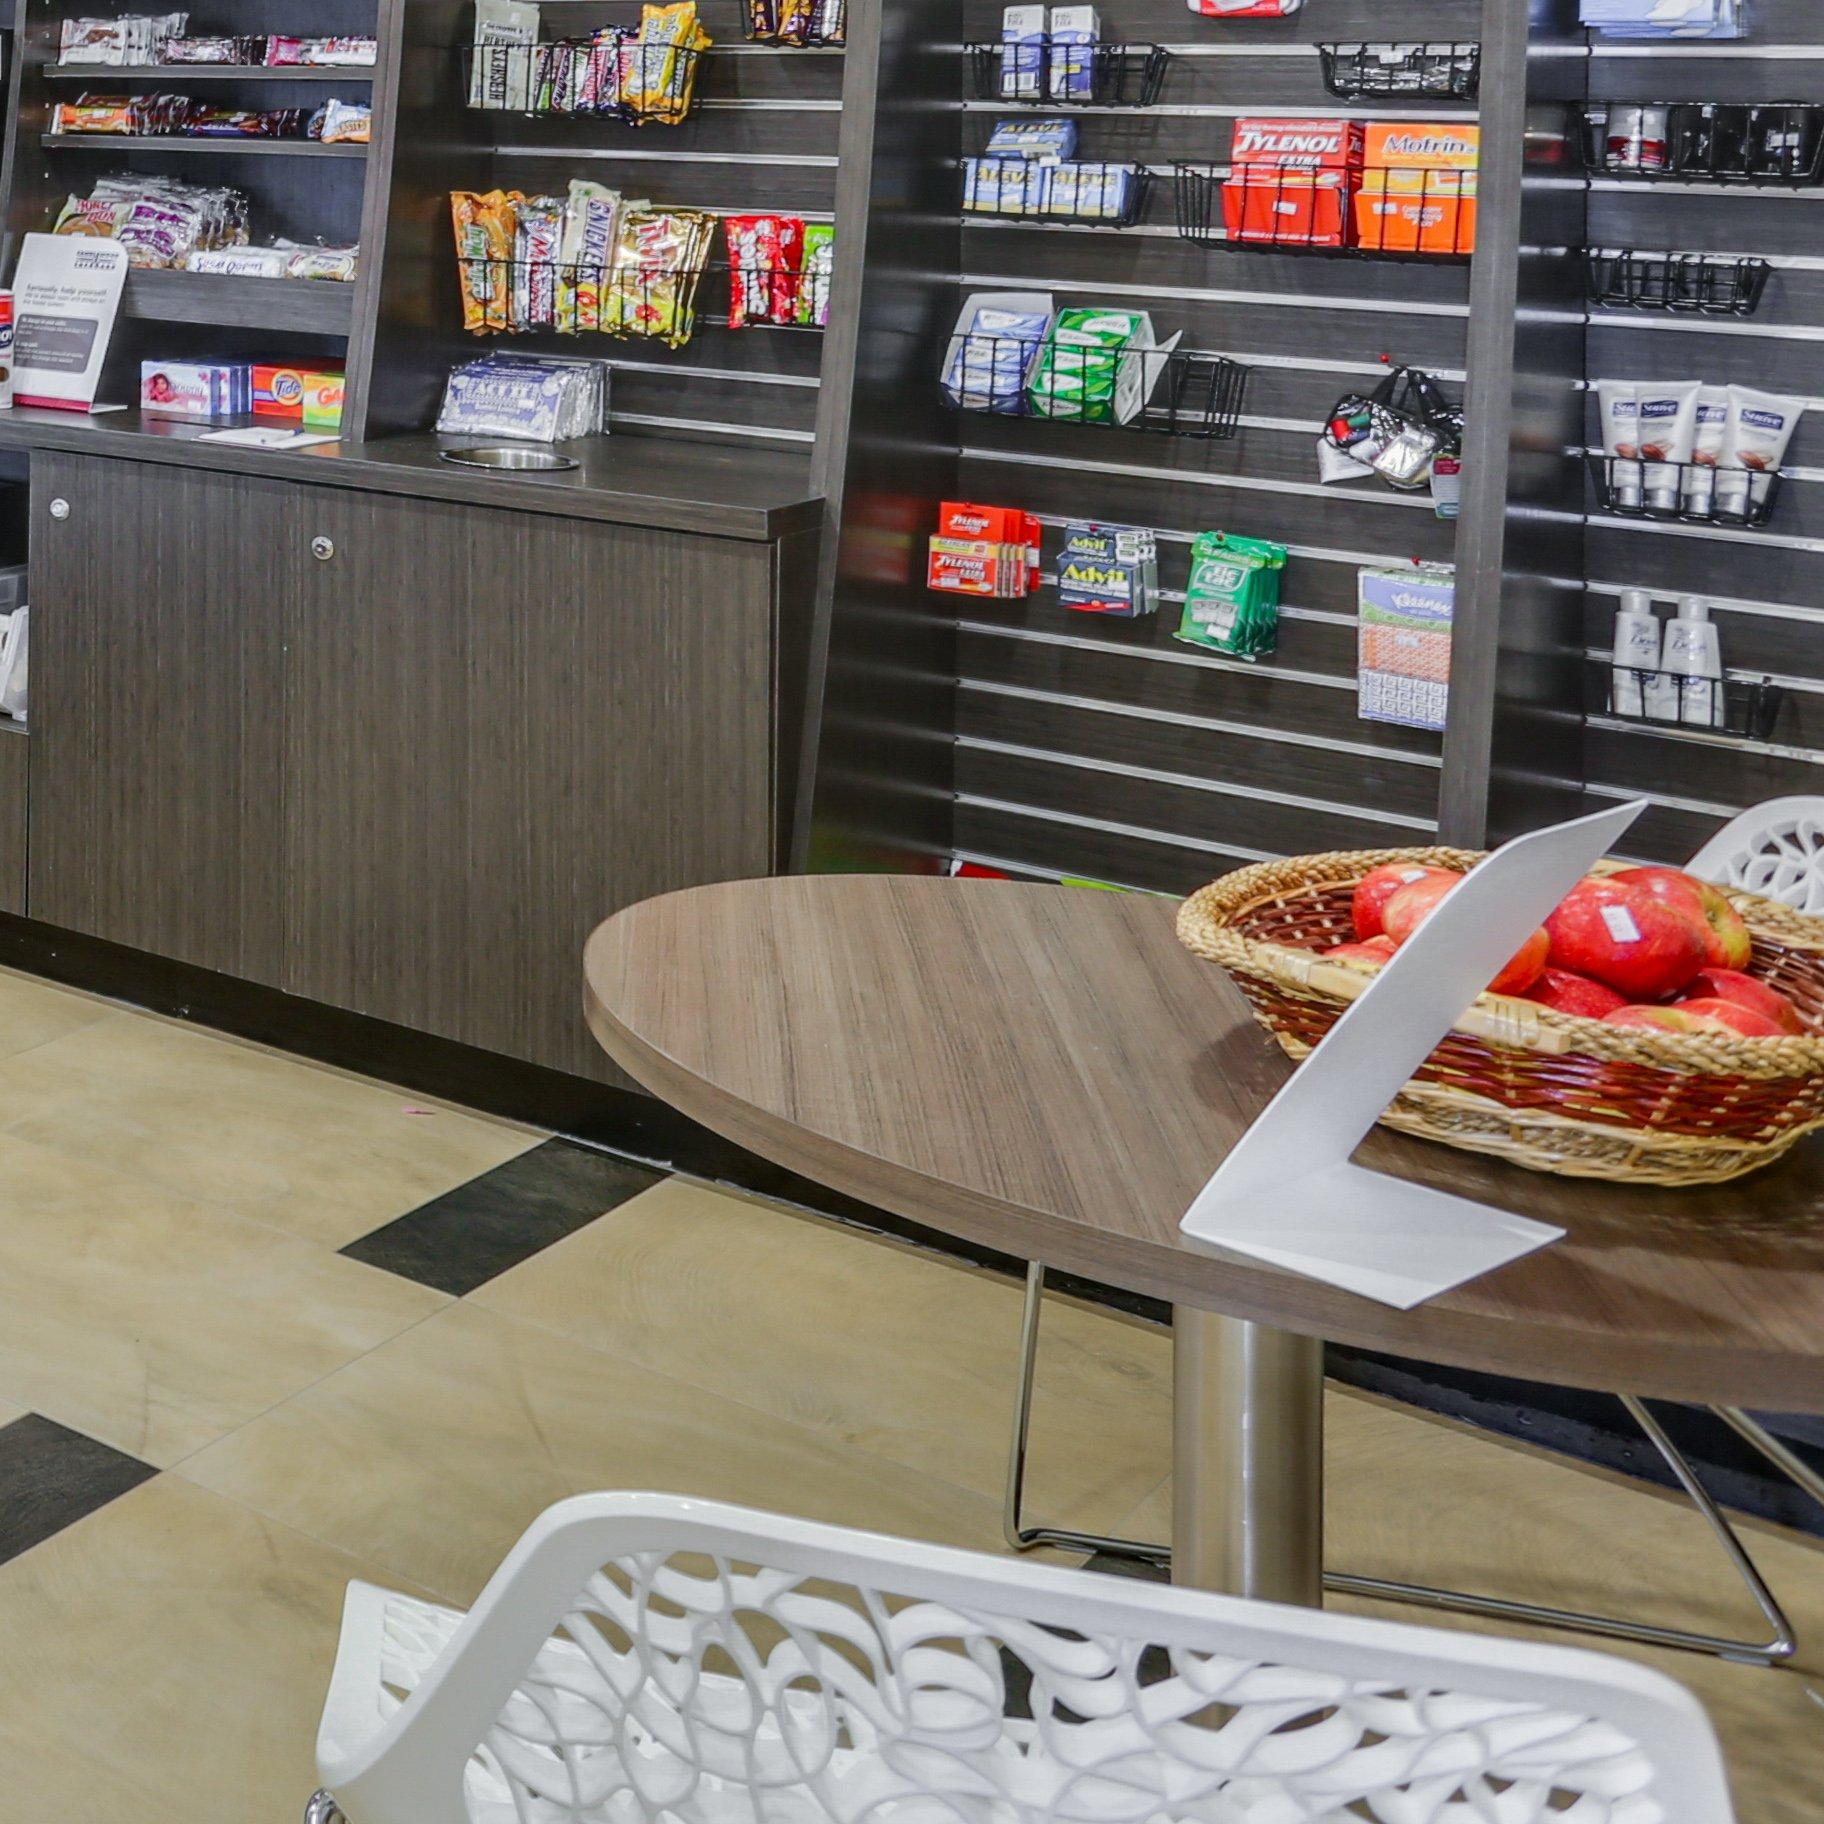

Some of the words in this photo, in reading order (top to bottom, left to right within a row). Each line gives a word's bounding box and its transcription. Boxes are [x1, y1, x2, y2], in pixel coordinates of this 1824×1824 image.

[1233, 131, 1341, 159] TYLENOL
[1382, 134, 1466, 154] Motrin
[275, 380, 301, 396] Tide
[1062, 564, 1126, 583] Advil
